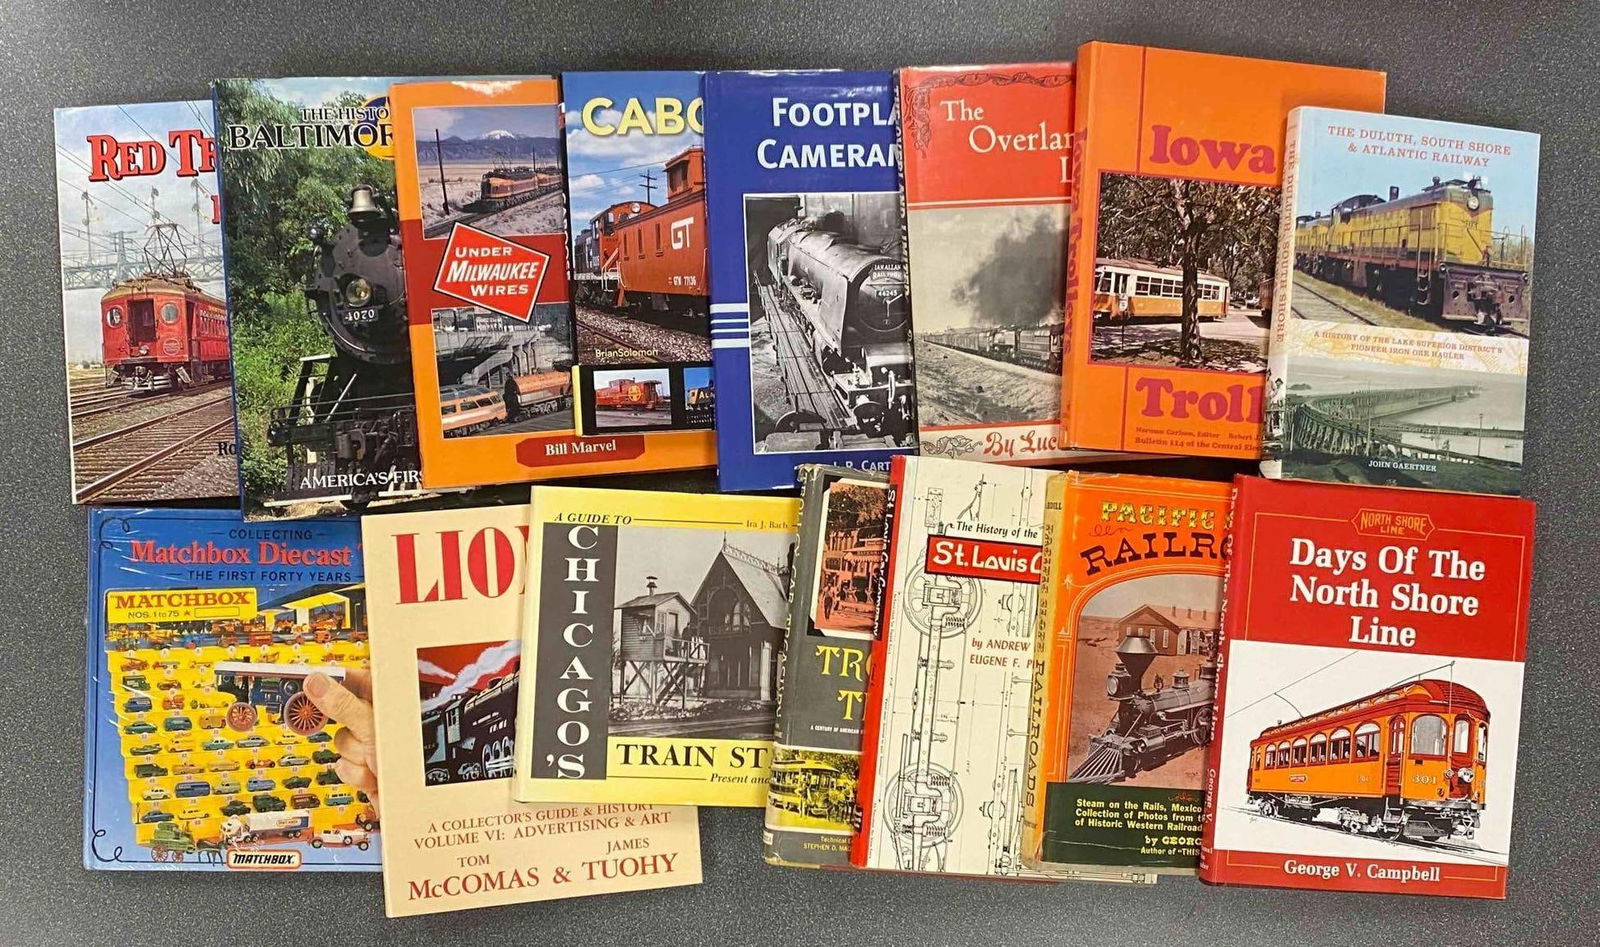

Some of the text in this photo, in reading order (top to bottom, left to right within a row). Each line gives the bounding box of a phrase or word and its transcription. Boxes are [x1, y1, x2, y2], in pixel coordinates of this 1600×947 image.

[300, 106, 390, 121] THE HISTO
[940, 99, 984, 123] The
[1328, 125, 1512, 156] THE DULUTH, SOUTH SHORE
[87, 134, 166, 181] RED
[1149, 125, 1277, 175] Iowa
[1347, 142, 1490, 168] & ATLANTIC RAILWAY
[671, 217, 695, 250] GT
[455, 247, 513, 258] UNDER
[446, 260, 539, 283] MILWAUKEE
[470, 284, 529, 297] WIRES
[1322, 332, 1358, 342] HISTORY
[1373, 336, 1390, 344] THE
[1392, 338, 1416, 346] LAKE
[1416, 340, 1457, 351] SUPERIOR
[1351, 343, 1465, 360] PIONEER IRON ORE HAULER
[545, 440, 617, 456] Bill Marvel
[983, 431, 1014, 457] By
[1196, 440, 1210, 448] the
[1368, 460, 1437, 473] JOHN GAERTNER
[300, 472, 389, 489] AMERICA'S
[554, 512, 632, 525] A GUIDE TO
[1101, 501, 1216, 530] PACIFIC
[1360, 513, 1428, 535] NORTH SHORE
[760, 520, 767, 530] J.
[769, 519, 788, 529] Bach
[957, 520, 1038, 539] The History of the
[1380, 525, 1405, 535] LINE
[229, 529, 313, 541] COLLECTING
[131, 540, 250, 566] Matchbox
[258, 541, 351, 567] Diecast
[1289, 537, 1486, 581] Days Of The
[391, 525, 530, 605] LIO
[188, 570, 351, 582] THE FIRST FORTY YEARS
[1289, 574, 1479, 617] North Shore
[168, 610, 180, 618] 75
[1348, 615, 1417, 647] Line
[972, 638, 1031, 652] by ANDREW
[815, 645, 872, 682] TR
[969, 654, 1020, 668] EUGENE F.
[1025, 660, 1045, 808] RAILROADS
[616, 743, 769, 769] TRAIN ST
[710, 772, 748, 784] Present
[1076, 798, 1105, 808] Steam
[1124, 801, 1139, 809] the
[1143, 802, 1167, 813] Rails,
[1171, 803, 1202, 813] Mexico
[428, 823, 438, 834] A
[442, 812, 533, 832] COLLECTOR'S
[535, 808, 579, 821] GUIDE
[583, 807, 593, 817] &
[1075, 808, 1193, 822] Collection of Photos from
[413, 812, 672, 850] VOLUME VI: ADVERTISING & ART
[1075, 818, 1084, 826] of
[1088, 818, 1123, 828] Historic
[1127, 820, 1163, 830] Western
[607, 837, 650, 854] JAMES
[803, 843, 830, 851] STEPHEN
[1145, 835, 1158, 846] by
[1140, 847, 1166, 855] Author
[1167, 847, 1176, 855] of
[457, 854, 490, 868] TOM
[408, 852, 679, 901] McCOMAS & TUOHY
[1284, 859, 1441, 884] George V. Campbell
